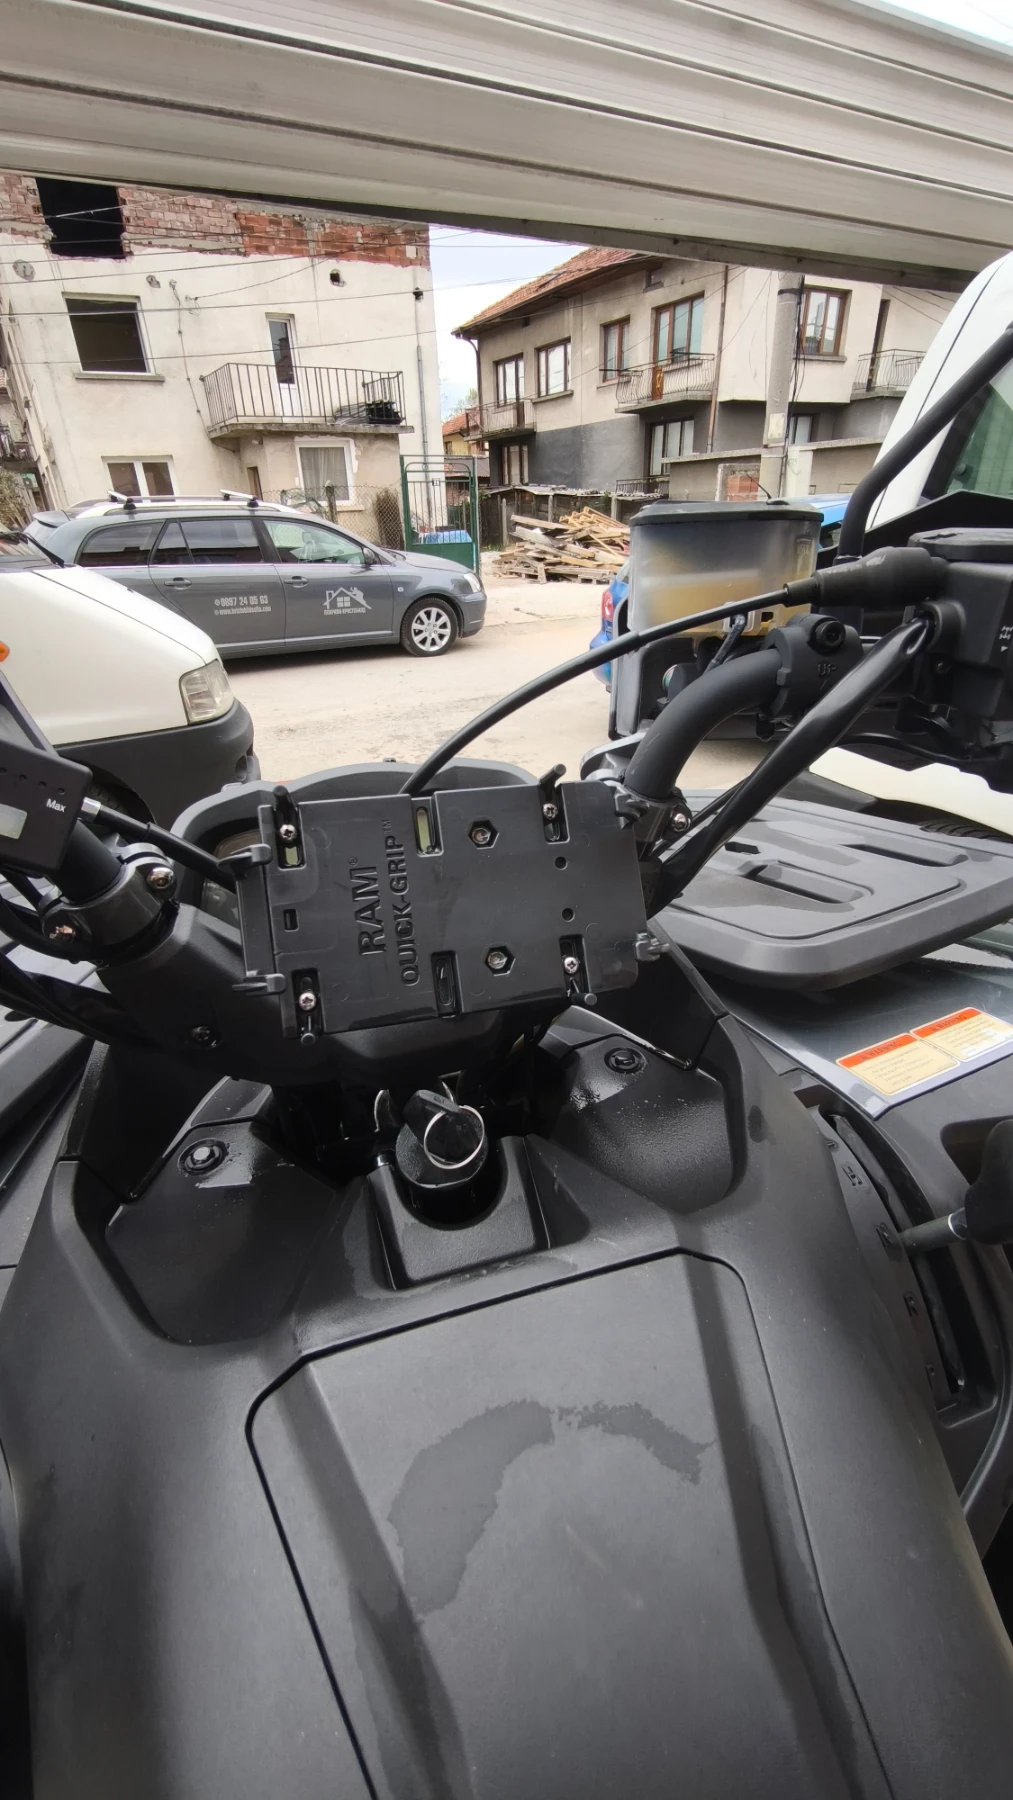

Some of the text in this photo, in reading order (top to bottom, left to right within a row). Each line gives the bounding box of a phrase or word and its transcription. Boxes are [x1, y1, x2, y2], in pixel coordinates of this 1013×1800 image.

[239, 596, 249, 606] 24
[250, 595, 259, 605] 05
[817, 663, 837, 677] UP
[46, 798, 66, 813] Max
[903, 1293, 919, 1318] R
